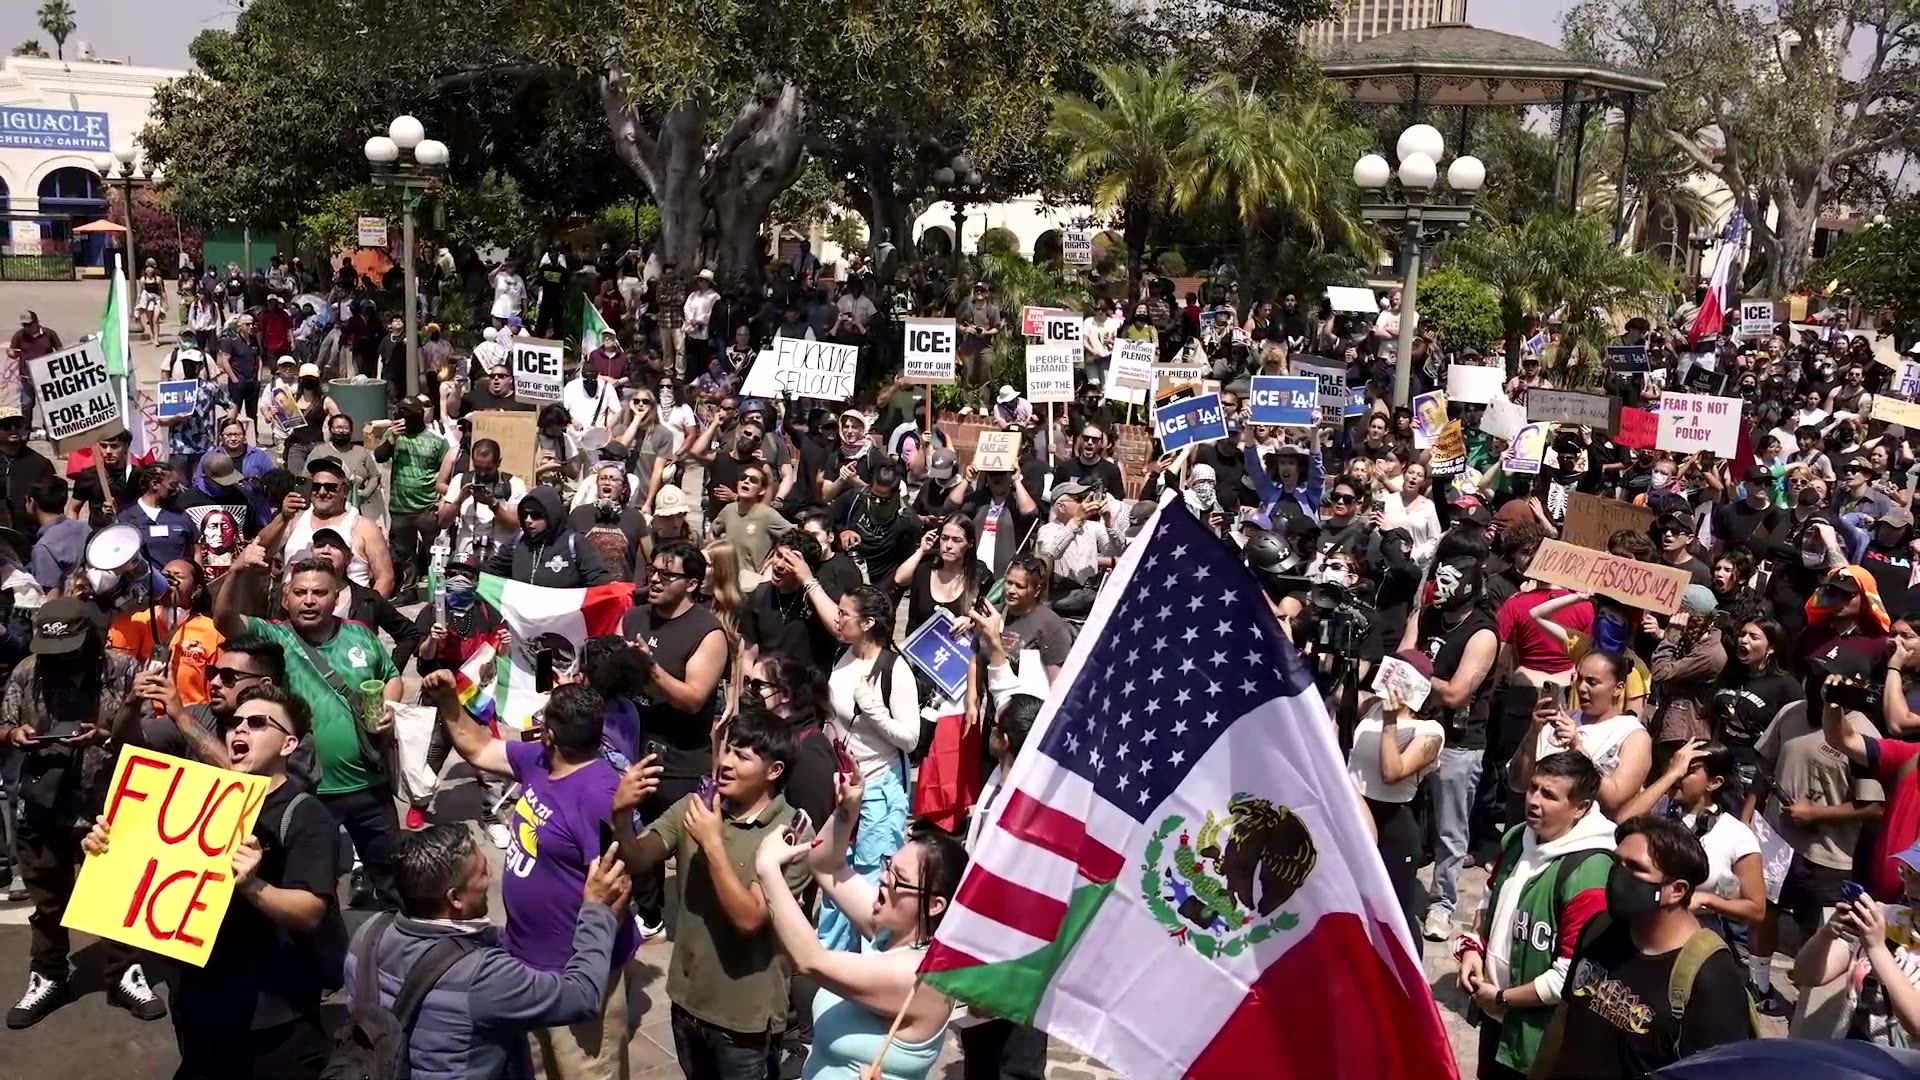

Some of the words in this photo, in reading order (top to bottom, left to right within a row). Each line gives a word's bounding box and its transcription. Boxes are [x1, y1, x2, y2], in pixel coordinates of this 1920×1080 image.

[0, 111, 106, 138] IGUACLE
[57, 138, 106, 147] CANTINA
[1064, 241, 1090, 249] RIGHTS
[1744, 306, 1770, 320] ICE:
[1047, 321, 1080, 341] ICE:
[909, 330, 951, 353] ICE:
[47, 350, 95, 379] FULL
[517, 349, 558, 376] ICE:
[778, 339, 857, 374] FUCKING
[1035, 355, 1070, 364] PEOPLE
[1121, 350, 1152, 363] PLENOS
[907, 361, 922, 369] OUT
[924, 362, 934, 370] OF
[936, 362, 951, 370] OUR
[907, 369, 951, 377] COMMUNITIES!
[1029, 364, 1071, 373] DEMAND:
[1169, 371, 1199, 379] PUEBLO
[1300, 369, 1343, 386] PEOPLE
[40, 365, 107, 402] RIGHTS
[517, 380, 531, 389] OUT
[532, 382, 543, 390] OF
[544, 383, 560, 392] OUR
[774, 370, 852, 398] SELLOUTS
[1030, 381, 1052, 390] STOP
[1055, 381, 1071, 389] THE
[160, 391, 178, 404] ICE
[1252, 390, 1280, 406] ICE
[1291, 390, 1314, 408] LA!
[48, 403, 85, 427] FOR
[89, 392, 116, 412] ALL
[1320, 405, 1342, 416] THE
[1663, 398, 1687, 411] FEAR
[1691, 401, 1703, 413] IS
[1707, 402, 1729, 415] NOT
[1160, 414, 1188, 438] ICE
[1197, 405, 1221, 426] LA!
[1691, 417, 1698, 427] A
[988, 433, 1012, 443] ICE
[1675, 427, 1711, 442] POLICY
[980, 442, 997, 452] OUT
[982, 455, 1003, 467] LA
[1533, 548, 1559, 572] NO
[1584, 556, 1653, 596] FASCISTS
[1649, 574, 1662, 594] IN
[1655, 576, 1680, 608] LA
[647, 635, 658, 648] hi.
[107, 755, 268, 857] FUCK
[123, 857, 226, 948] ICE
